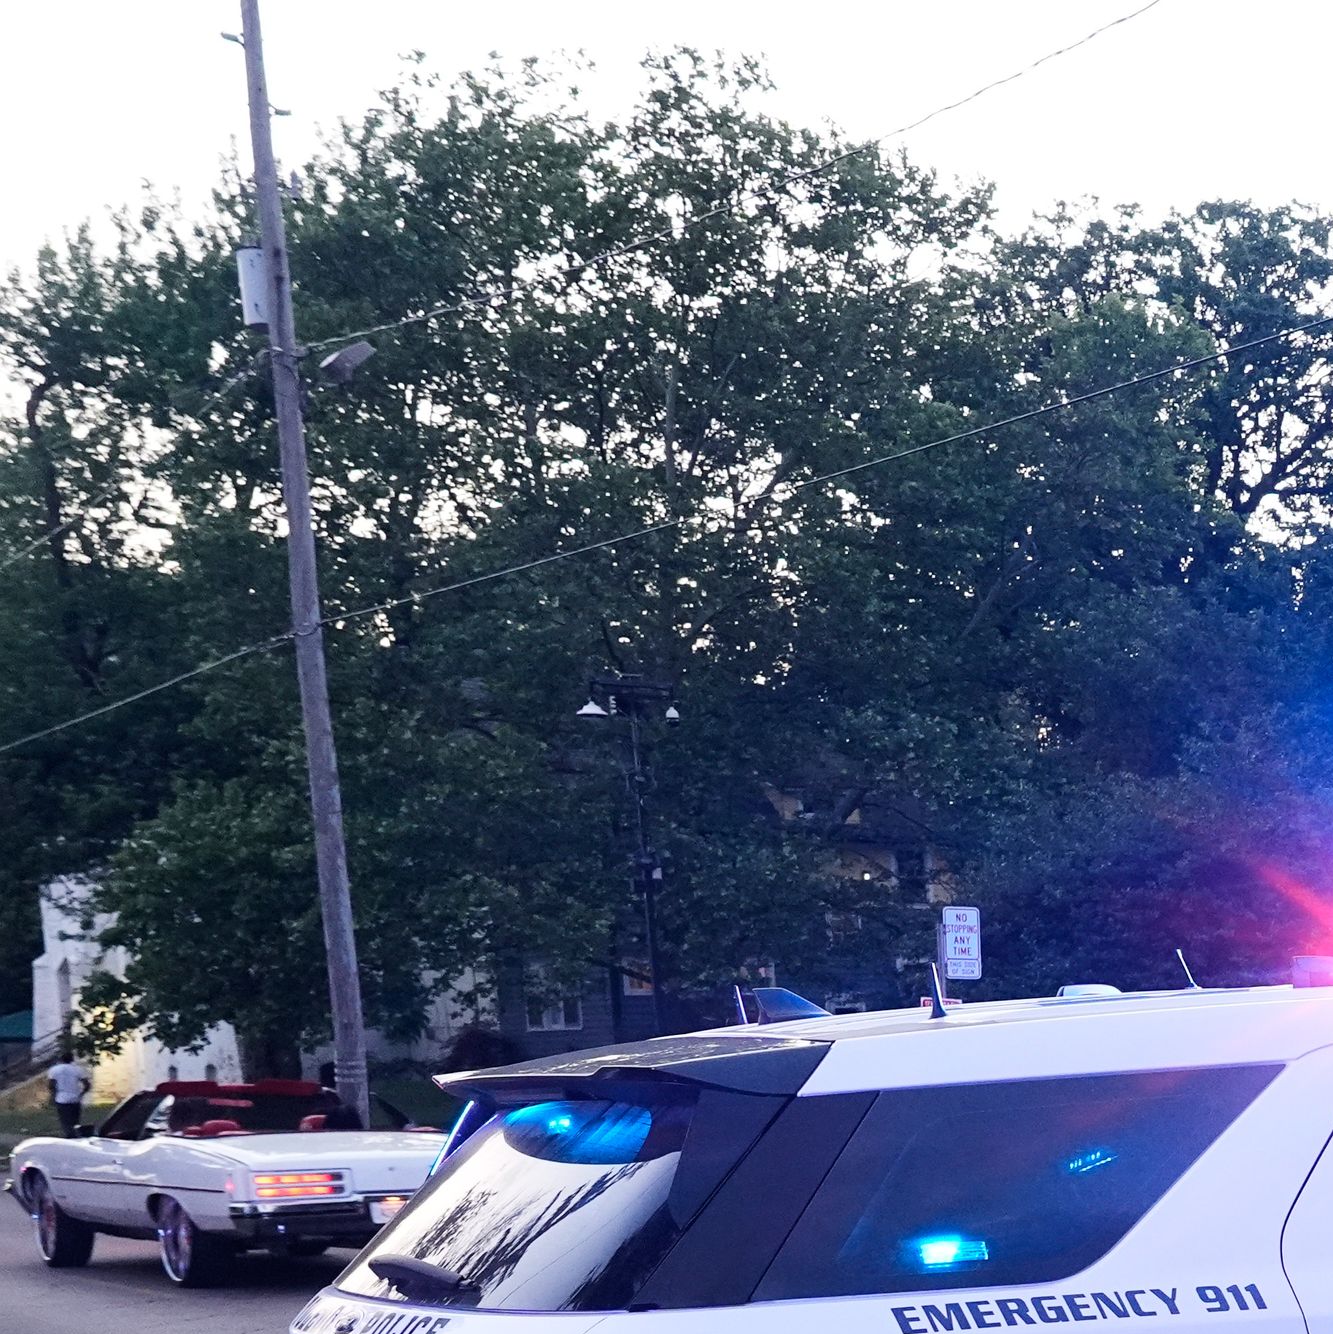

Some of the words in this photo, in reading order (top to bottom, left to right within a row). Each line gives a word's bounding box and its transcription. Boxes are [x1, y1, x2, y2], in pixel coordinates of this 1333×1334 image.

[955, 913, 968, 923] NO
[947, 923, 977, 934] STOPPING
[953, 935, 971, 945] ANY
[953, 946, 971, 956] TIME
[1195, 1283, 1268, 1313] 911
